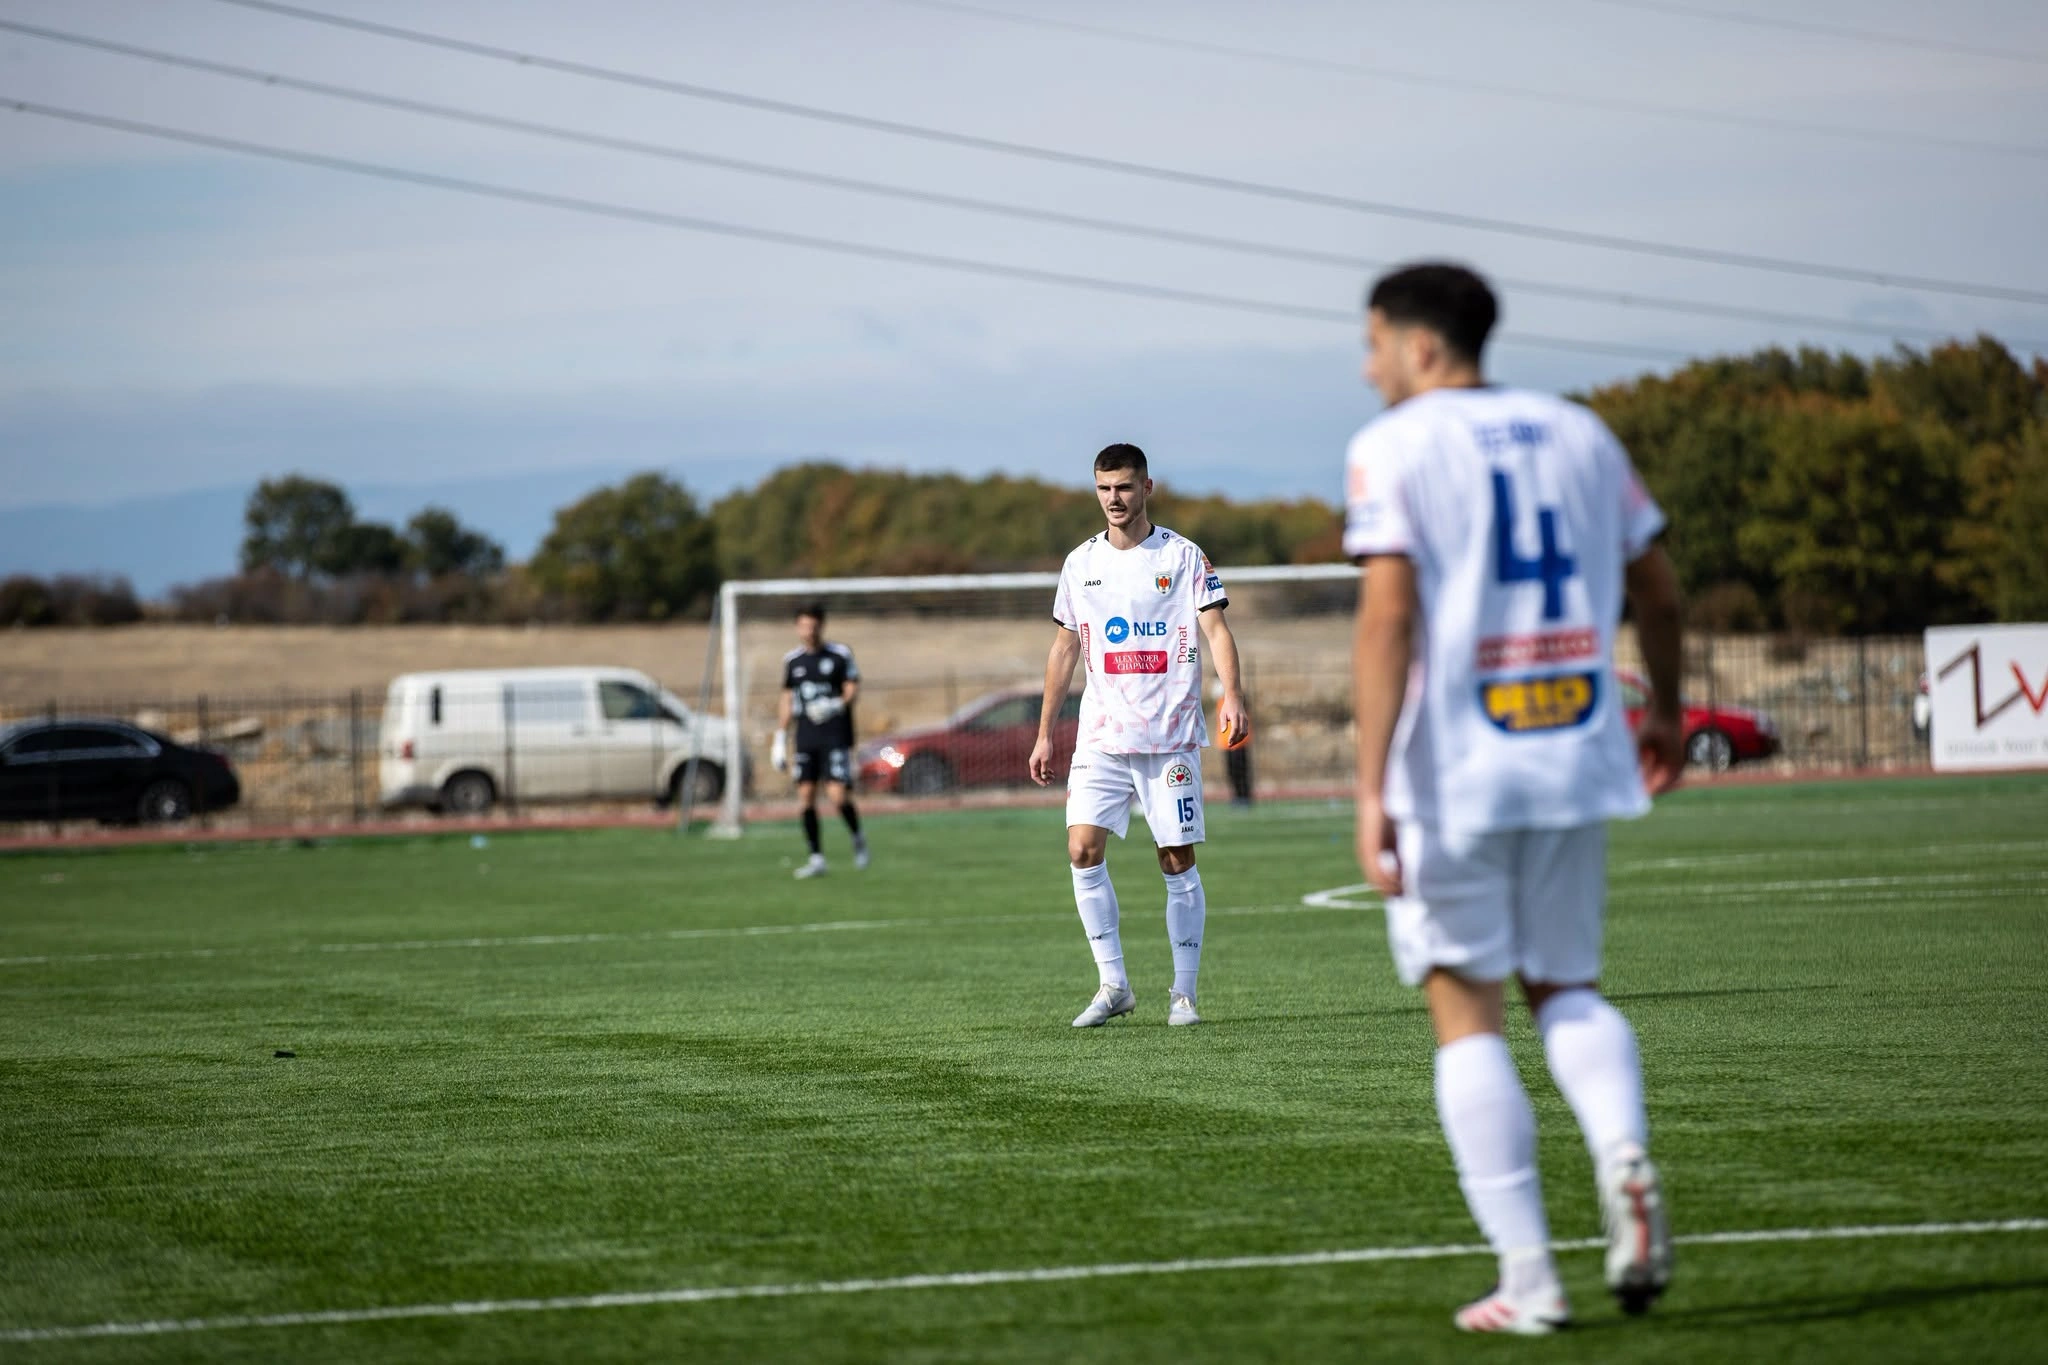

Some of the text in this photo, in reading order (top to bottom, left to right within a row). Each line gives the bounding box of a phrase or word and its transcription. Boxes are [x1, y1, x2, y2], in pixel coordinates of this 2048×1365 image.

[1491, 466, 1577, 620] 4
[1133, 621, 1167, 636] NLB
[1177, 625, 1187, 664] Donat
[1113, 654, 1159, 664] ALEXANDER
[1188, 647, 1197, 663] Mg
[1117, 662, 1155, 670] CHAPMAN
[1169, 767, 1190, 784] VITALIA
[1177, 797, 1194, 823] 15
